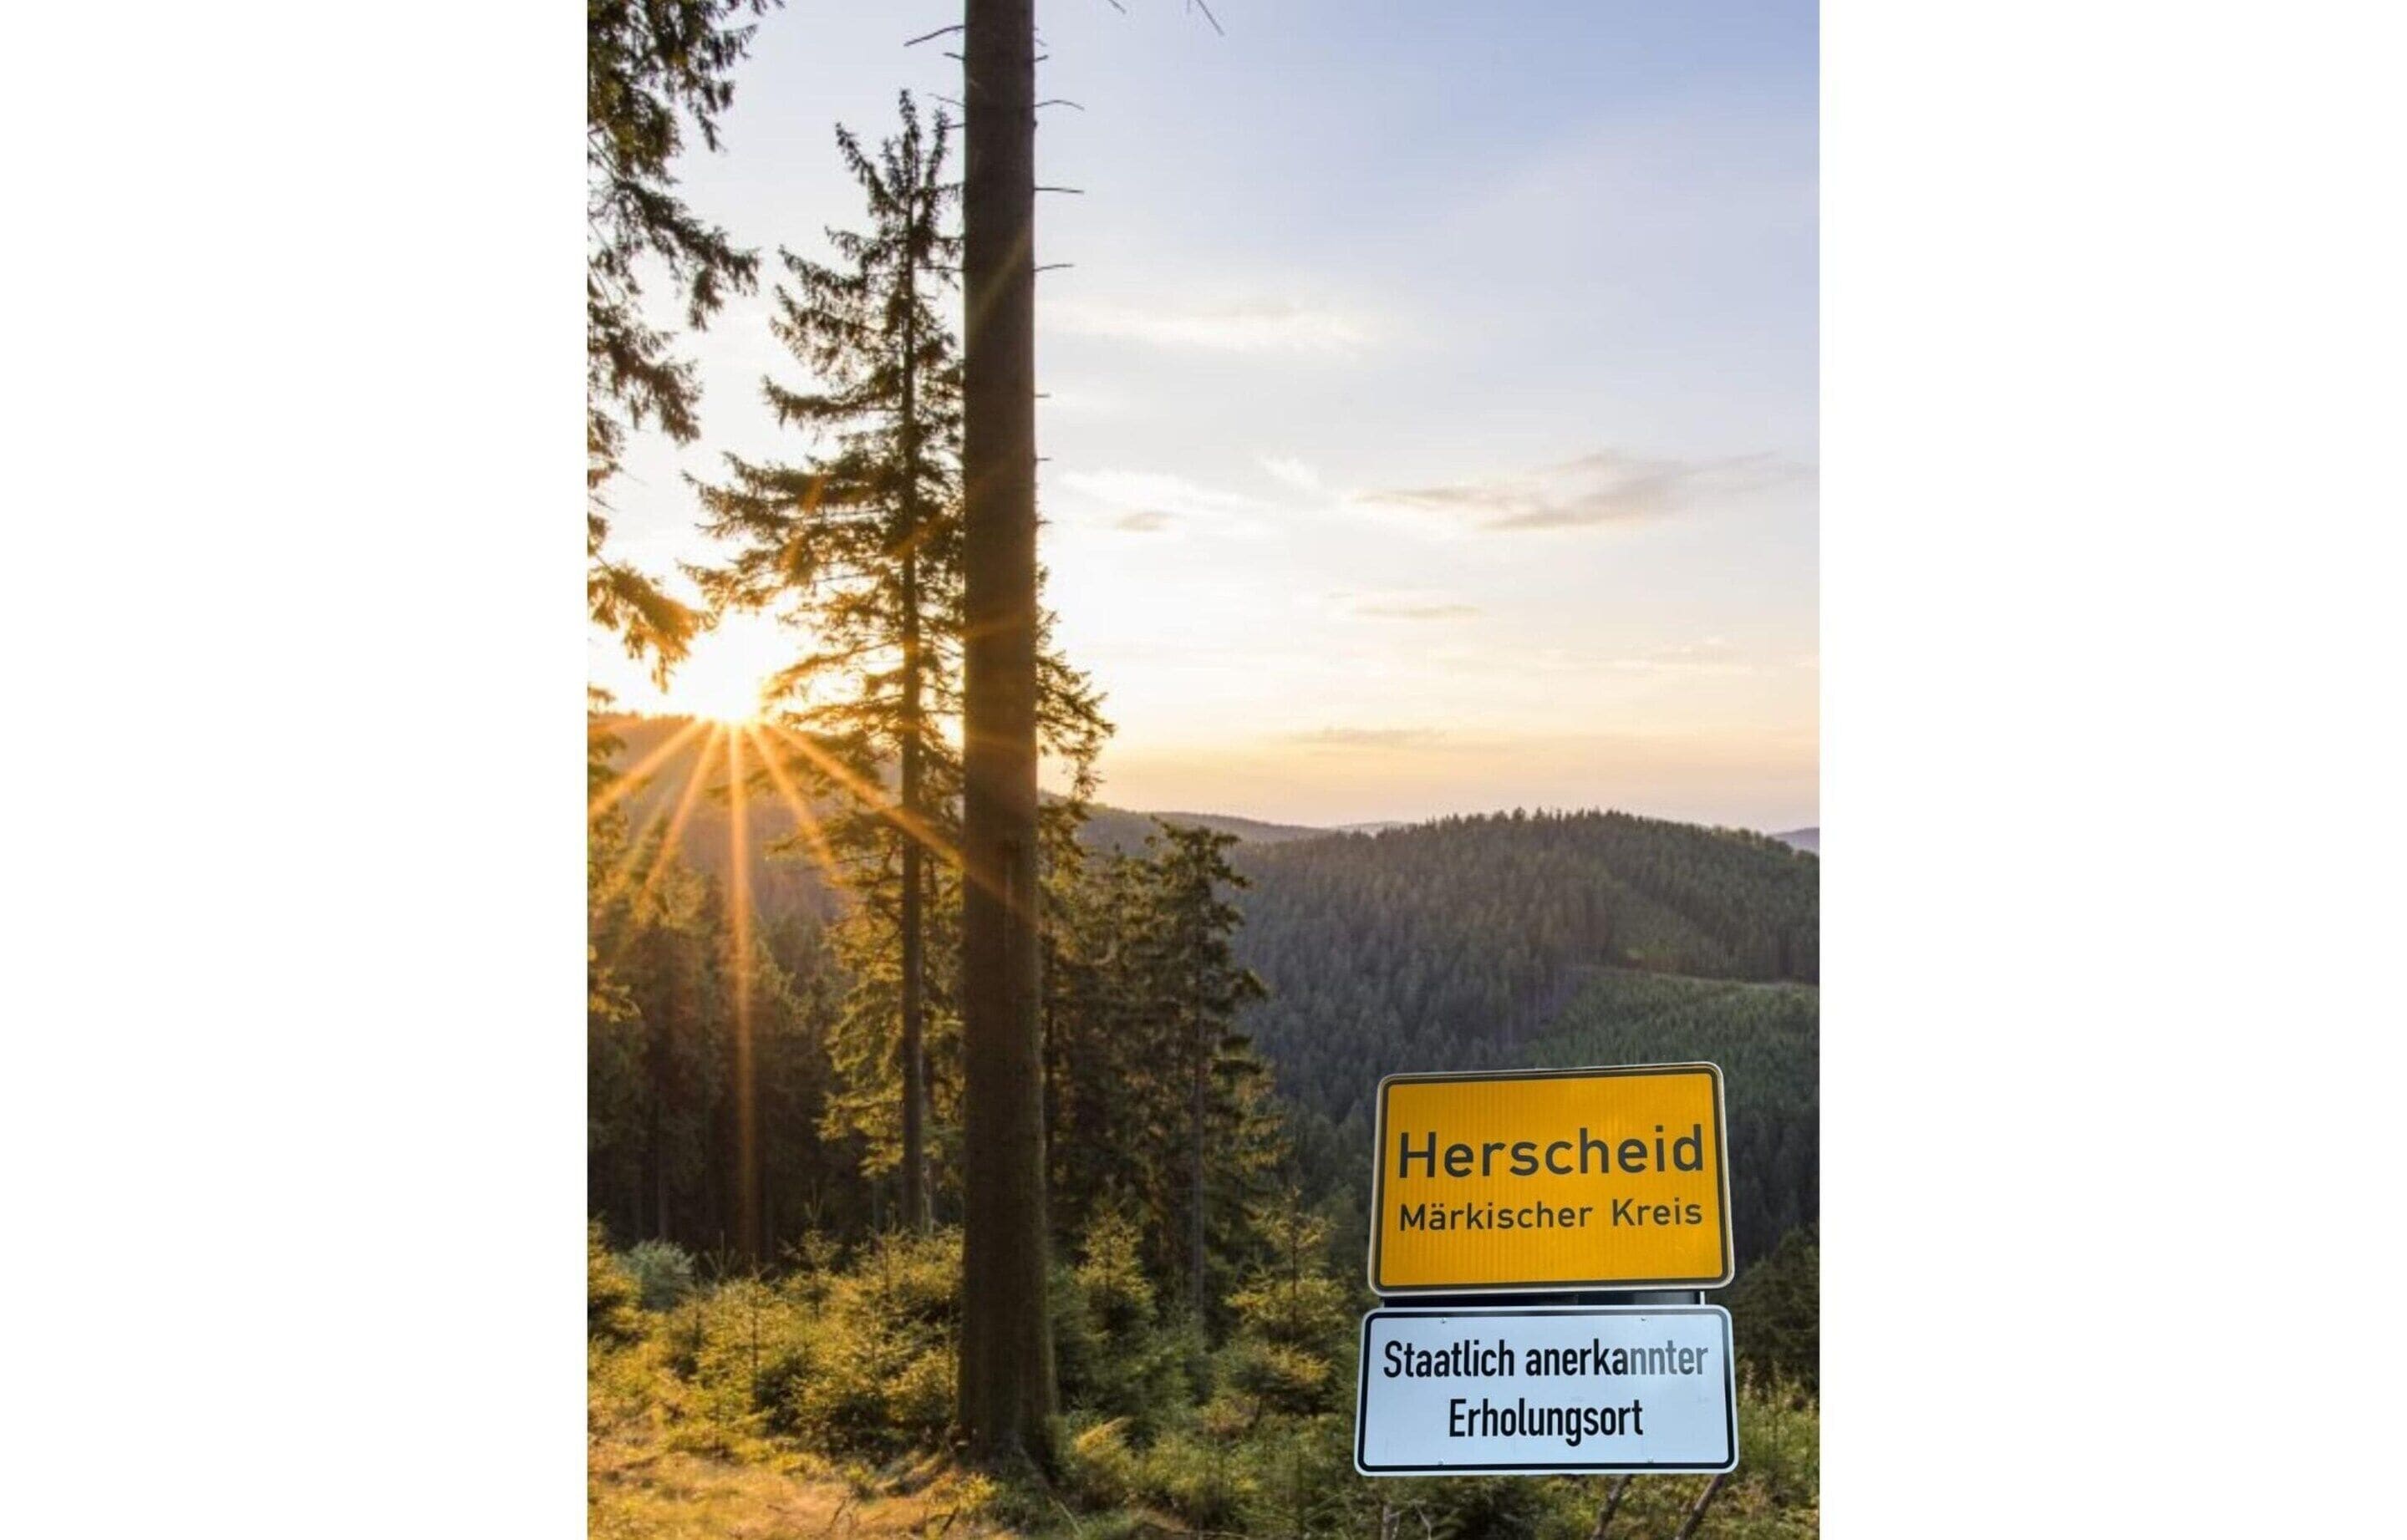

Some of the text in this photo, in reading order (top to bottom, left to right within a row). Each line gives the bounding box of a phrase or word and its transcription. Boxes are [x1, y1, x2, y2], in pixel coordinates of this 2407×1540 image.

[1398, 1124, 1704, 1178] Herscheid
[1400, 1197, 1702, 1231] Märkischer Kreis
[1383, 1339, 1708, 1378] Staatlich anerkannter
[1448, 1397, 1643, 1446] Erholungsort
